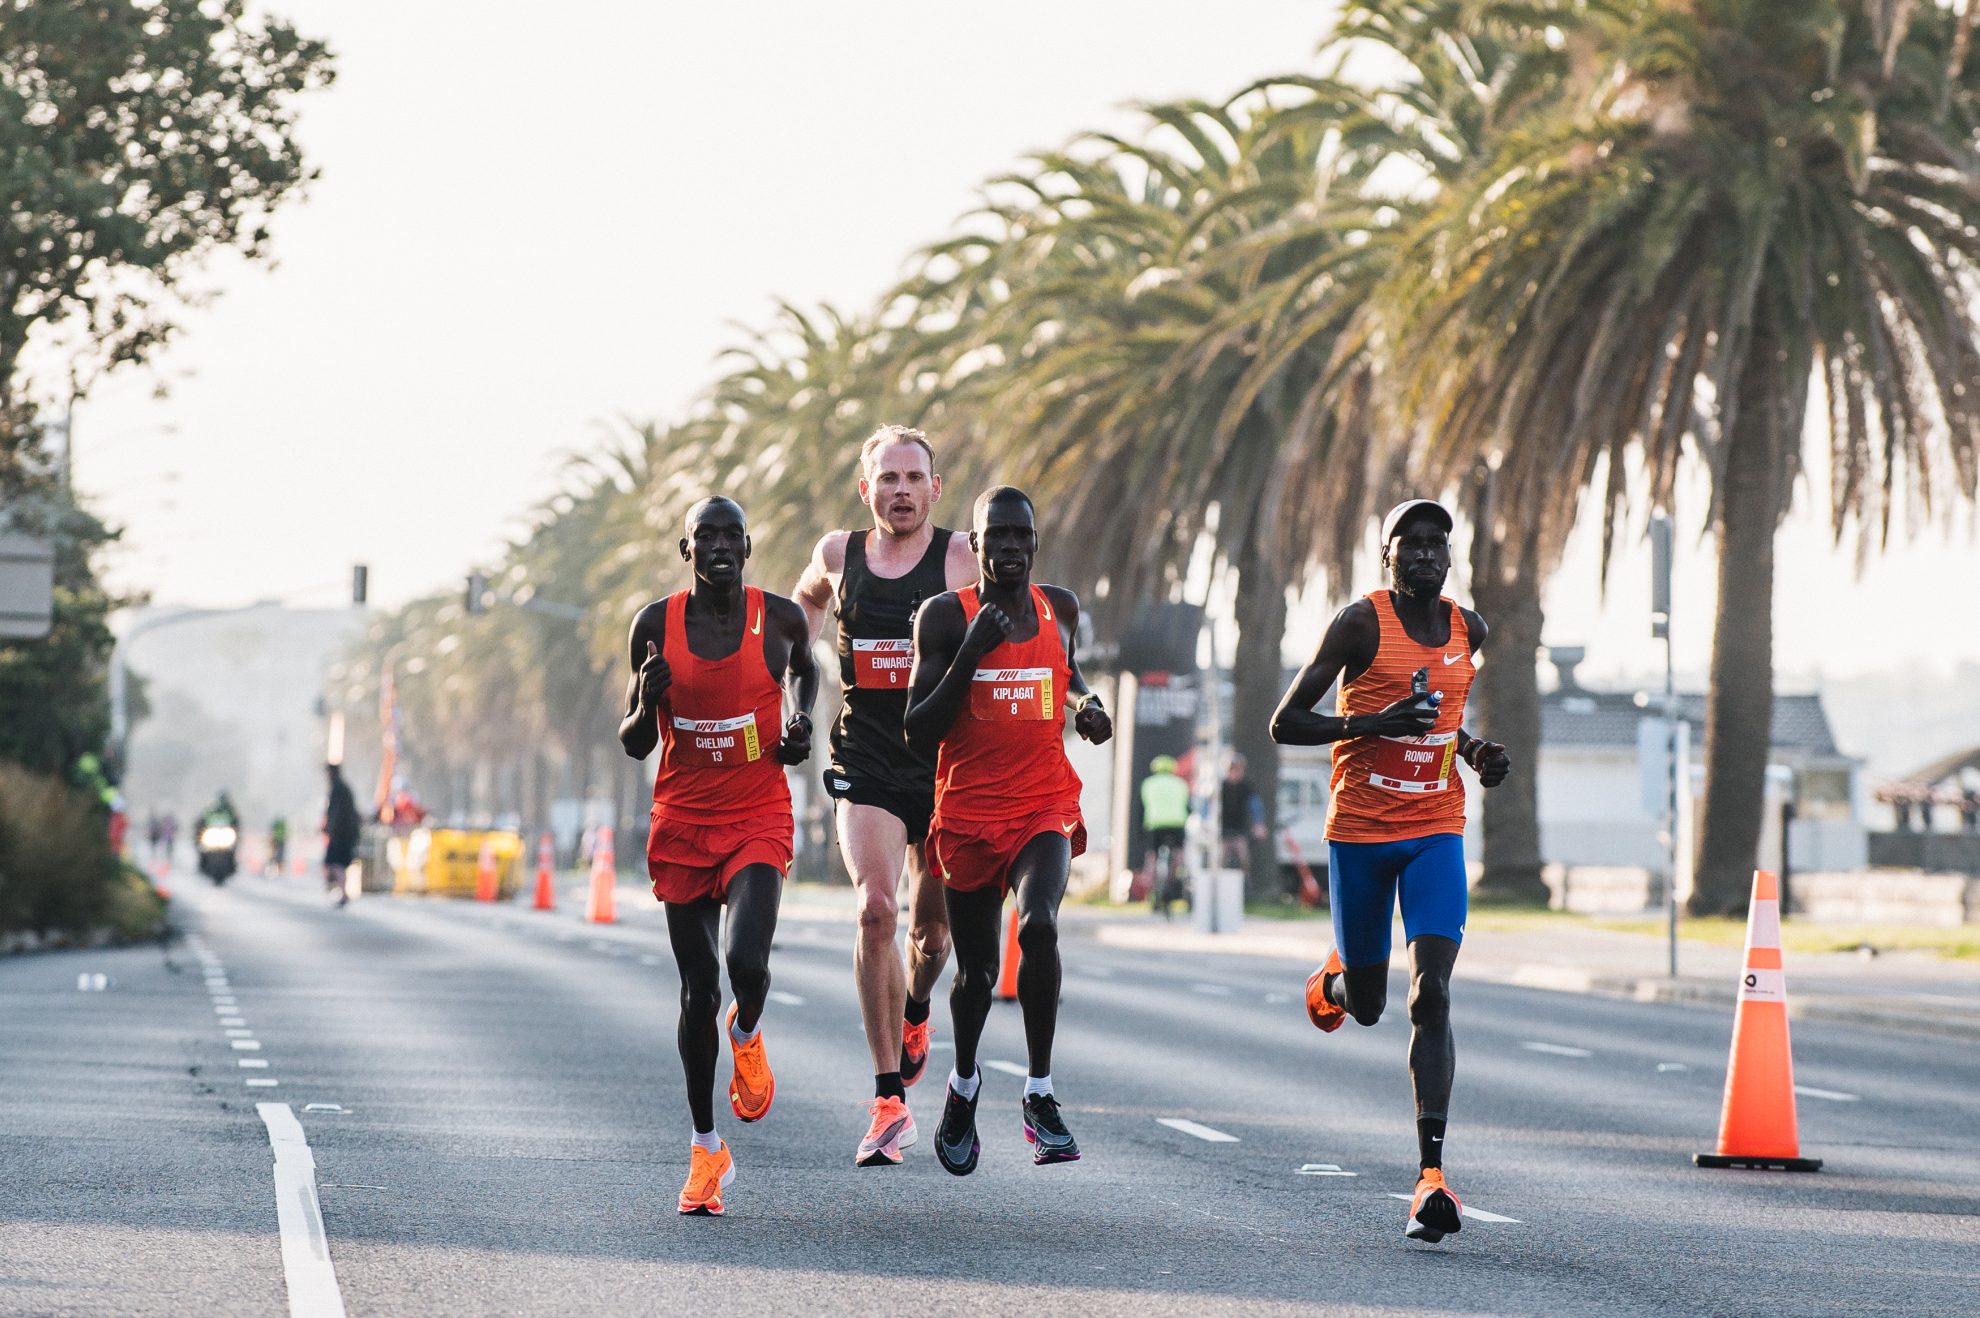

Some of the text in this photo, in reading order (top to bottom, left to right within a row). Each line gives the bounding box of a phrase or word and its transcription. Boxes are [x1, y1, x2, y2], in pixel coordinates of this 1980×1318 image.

[872, 657, 913, 669] EDWARDS
[889, 671, 897, 683] 6
[993, 687, 1035, 700] KIPLAGAT
[1010, 702, 1018, 715] 8
[1043, 691, 1052, 718] ELITE
[696, 736, 735, 749] CHELIMO
[747, 735, 758, 760] ELITE
[711, 751, 723, 762] 13
[1404, 750, 1435, 763] RONOH
[1413, 765, 1421, 777] 7
